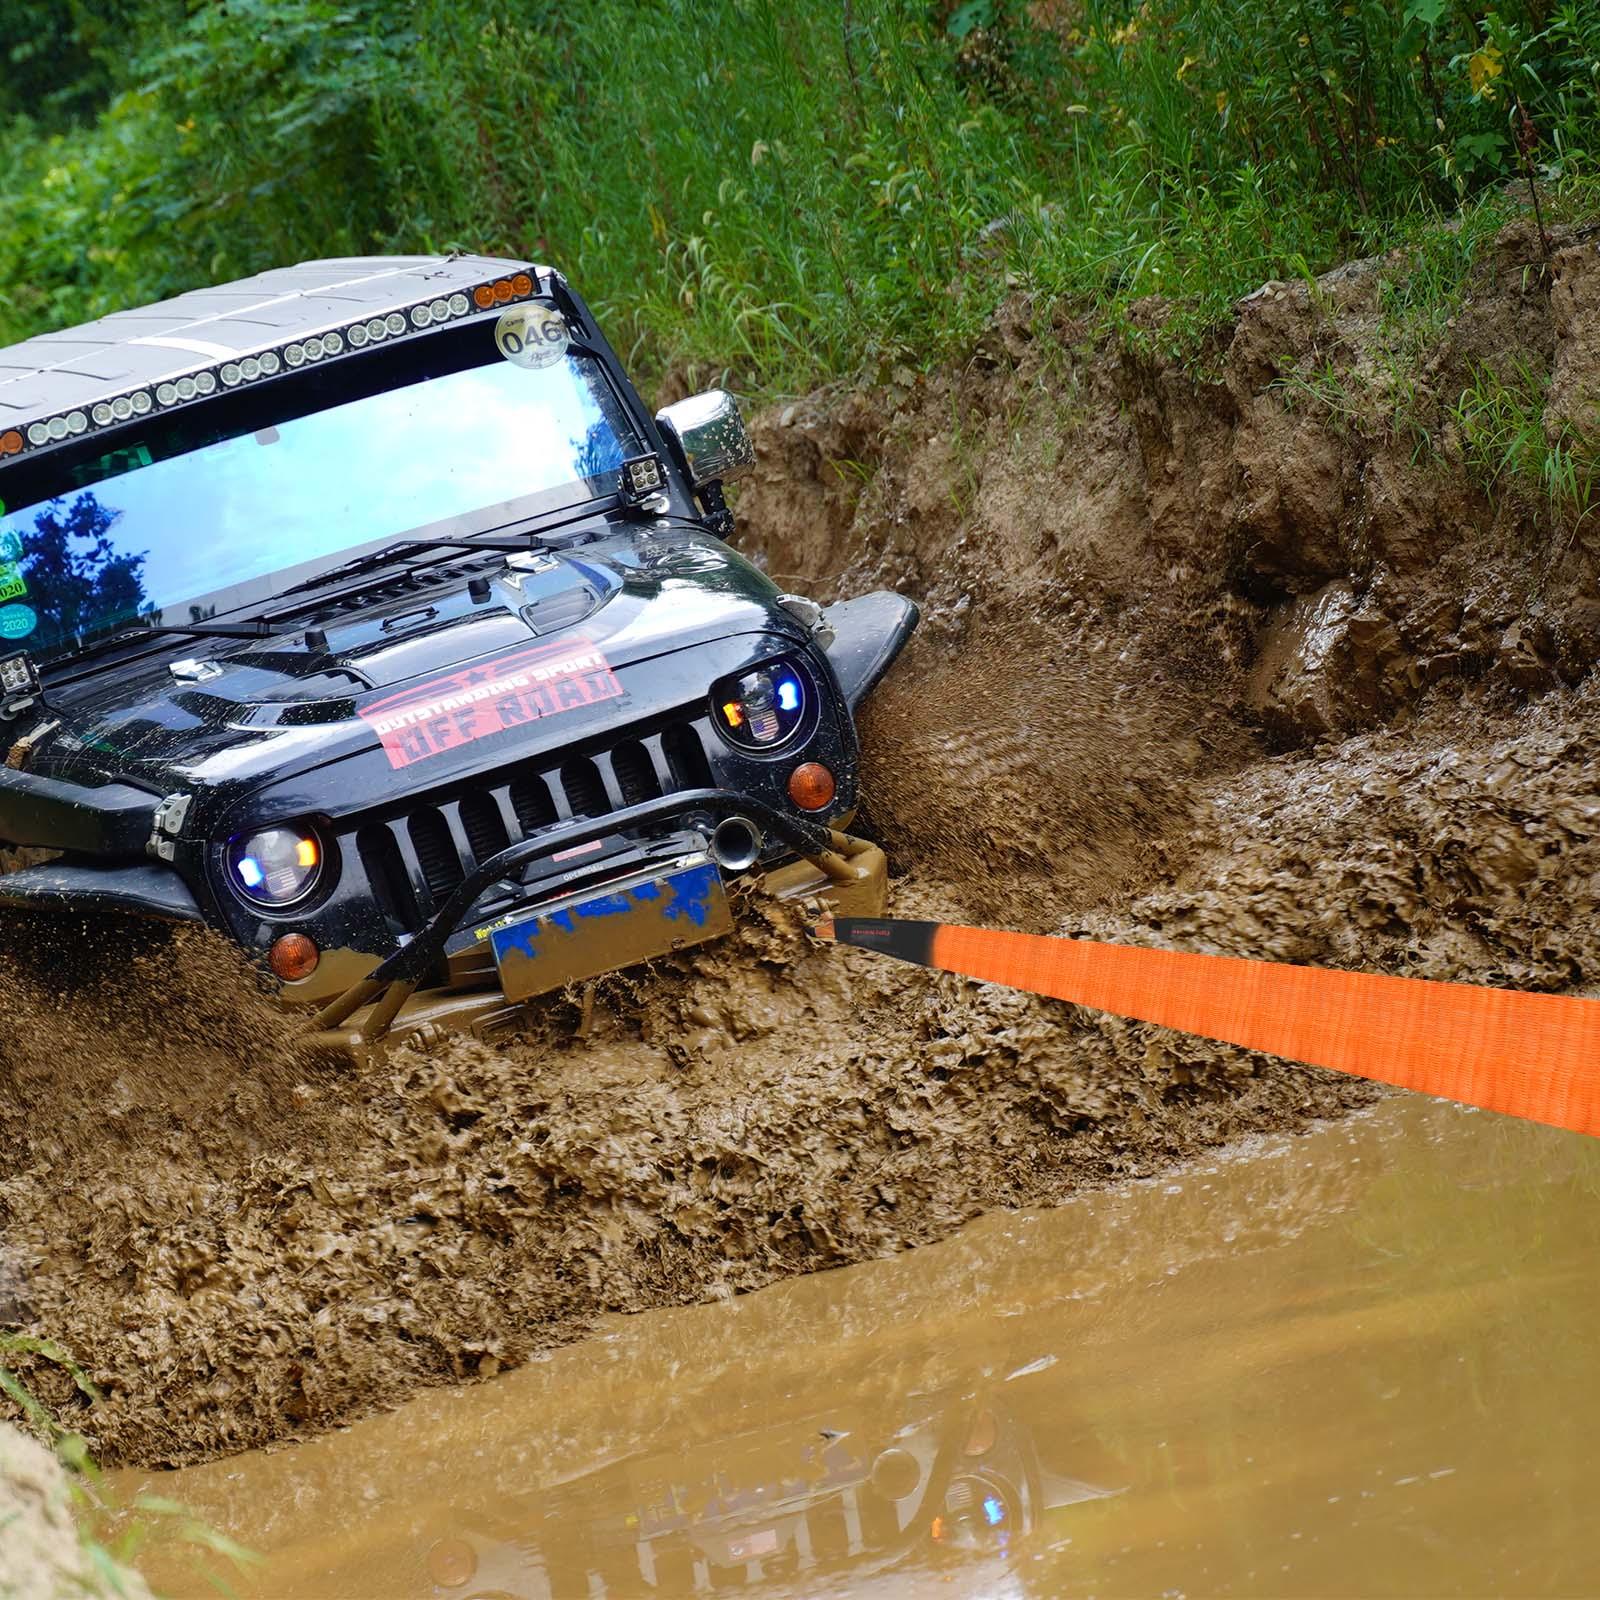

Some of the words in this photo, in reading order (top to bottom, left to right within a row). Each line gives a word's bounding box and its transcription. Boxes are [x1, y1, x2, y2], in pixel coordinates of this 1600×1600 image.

[502, 320, 561, 354] 046
[2, 617, 28, 632] 2020
[375, 675, 529, 736] OUTSTANDING
[532, 652, 603, 686] SPORT
[398, 708, 478, 761] OFF
[496, 672, 616, 726] ROAD
